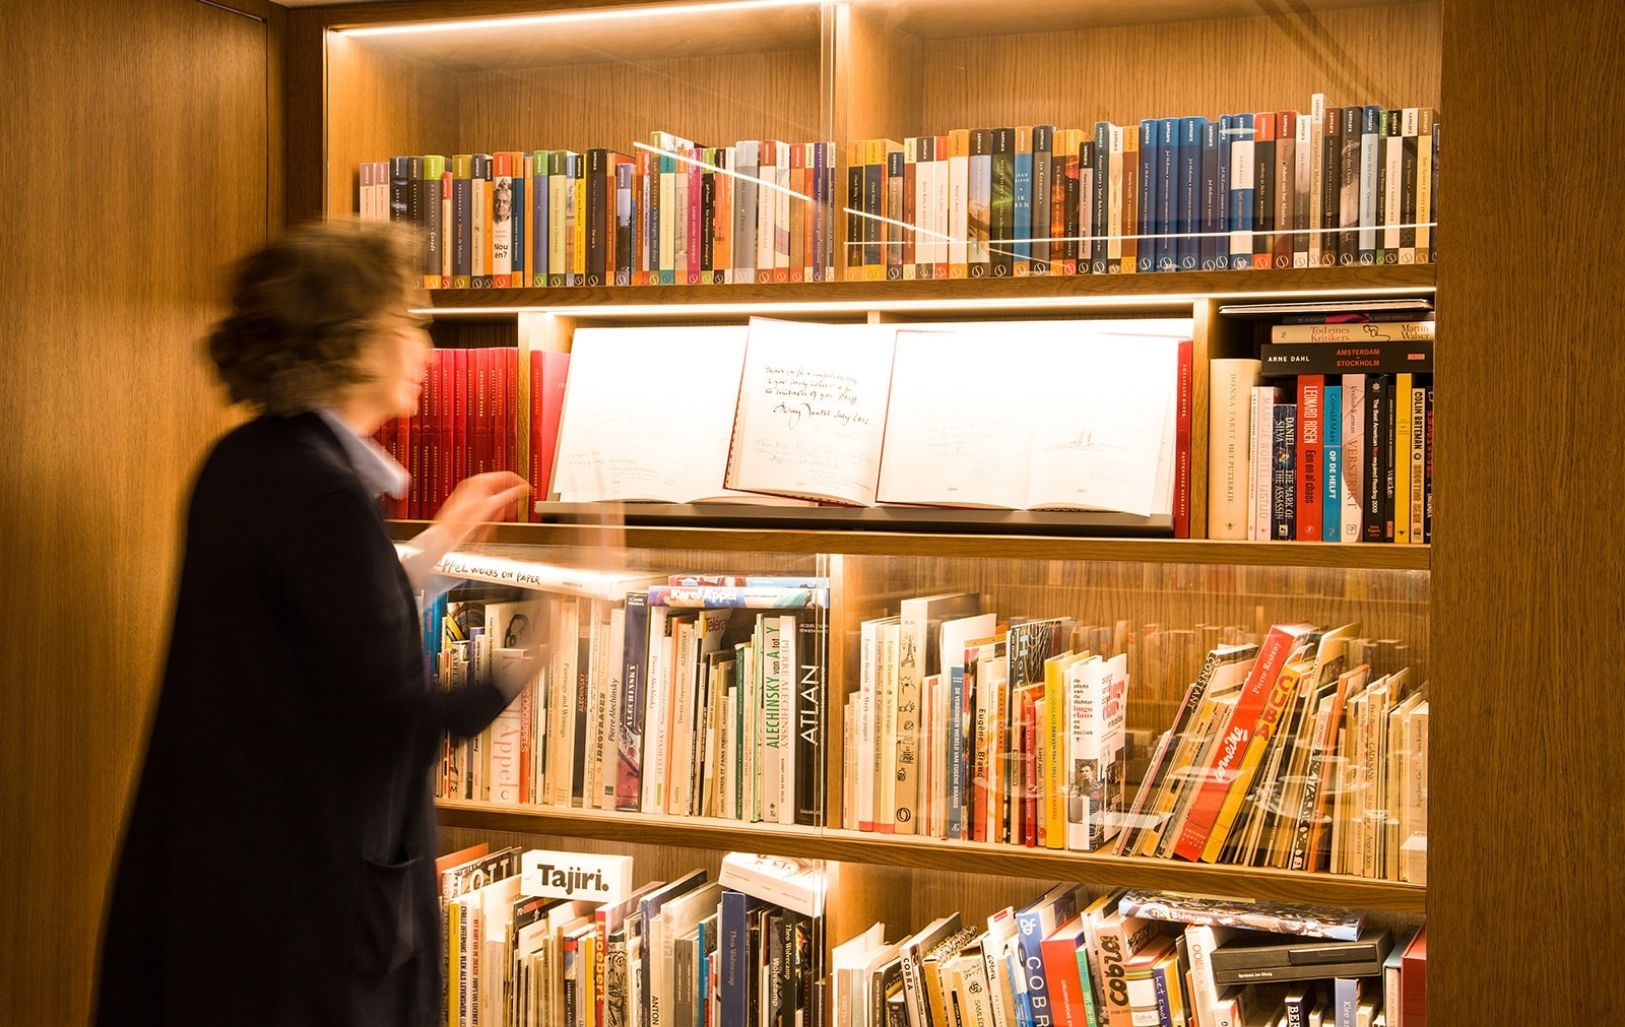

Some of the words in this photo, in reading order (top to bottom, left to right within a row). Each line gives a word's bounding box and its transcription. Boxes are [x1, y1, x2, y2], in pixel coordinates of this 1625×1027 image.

[1310, 326, 1327, 336] Tod
[1327, 326, 1350, 335] eines
[1400, 324, 1429, 332] Martin
[1400, 332, 1430, 341] Walser
[1336, 348, 1380, 356] AMSTERDAM
[1303, 386, 1318, 418] LEONARD
[1414, 391, 1423, 414] COLIN
[1275, 420, 1284, 443] SILVA
[1285, 416, 1294, 447] DANIEL
[1303, 420, 1318, 444] ROSEN
[1414, 416, 1423, 450] BATEMAN
[1305, 450, 1315, 463] Een
[1328, 450, 1336, 460] OP
[1275, 469, 1284, 484] THE
[1285, 469, 1294, 485] THE
[1305, 472, 1315, 481] al
[1328, 464, 1336, 473] DE
[1285, 486, 1294, 508] MARK
[1304, 482, 1315, 504] chaos
[1328, 474, 1336, 500] HELFT
[1370, 478, 1379, 499] Reading
[1275, 485, 1285, 519] ASSASSIN
[1371, 500, 1379, 514] 2009
[1284, 509, 1293, 519] OF
[471, 567, 498, 578] WORKS
[502, 570, 513, 579] ON
[517, 572, 542, 585] PAPER
[766, 625, 780, 635] Y
[771, 637, 780, 648] tot
[766, 651, 780, 659] A
[781, 639, 789, 674] PIERRE
[772, 661, 780, 675] van
[1251, 673, 1268, 695] Pierre
[1265, 643, 1282, 671] Restany
[1187, 652, 1217, 709] CONSTANT
[560, 694, 568, 708] and
[577, 673, 586, 713] ALECHINSKY
[608, 678, 619, 719] Alechinsky
[627, 664, 637, 727] ALECHINSKY
[766, 676, 779, 749] ALECHINSKY
[780, 676, 790, 749] ALECHINSKY
[800, 664, 819, 746] ATLAN
[608, 719, 616, 742] Pierre
[976, 708, 986, 743] Eugène
[952, 728, 960, 750] WERELD
[492, 722, 519, 788] Appel
[952, 751, 960, 761] VAN
[536, 863, 610, 895] Tajiri.
[728, 930, 738, 947] Theo
[784, 923, 793, 941] Theo
[596, 920, 605, 1002] Lucebert
[783, 942, 792, 980] Wolvecamp
[772, 957, 780, 1007] Wolvecamp
[904, 957, 913, 991] COBRA
[651, 995, 659, 1026] ANTON
[1343, 1001, 1351, 1017] Klee
